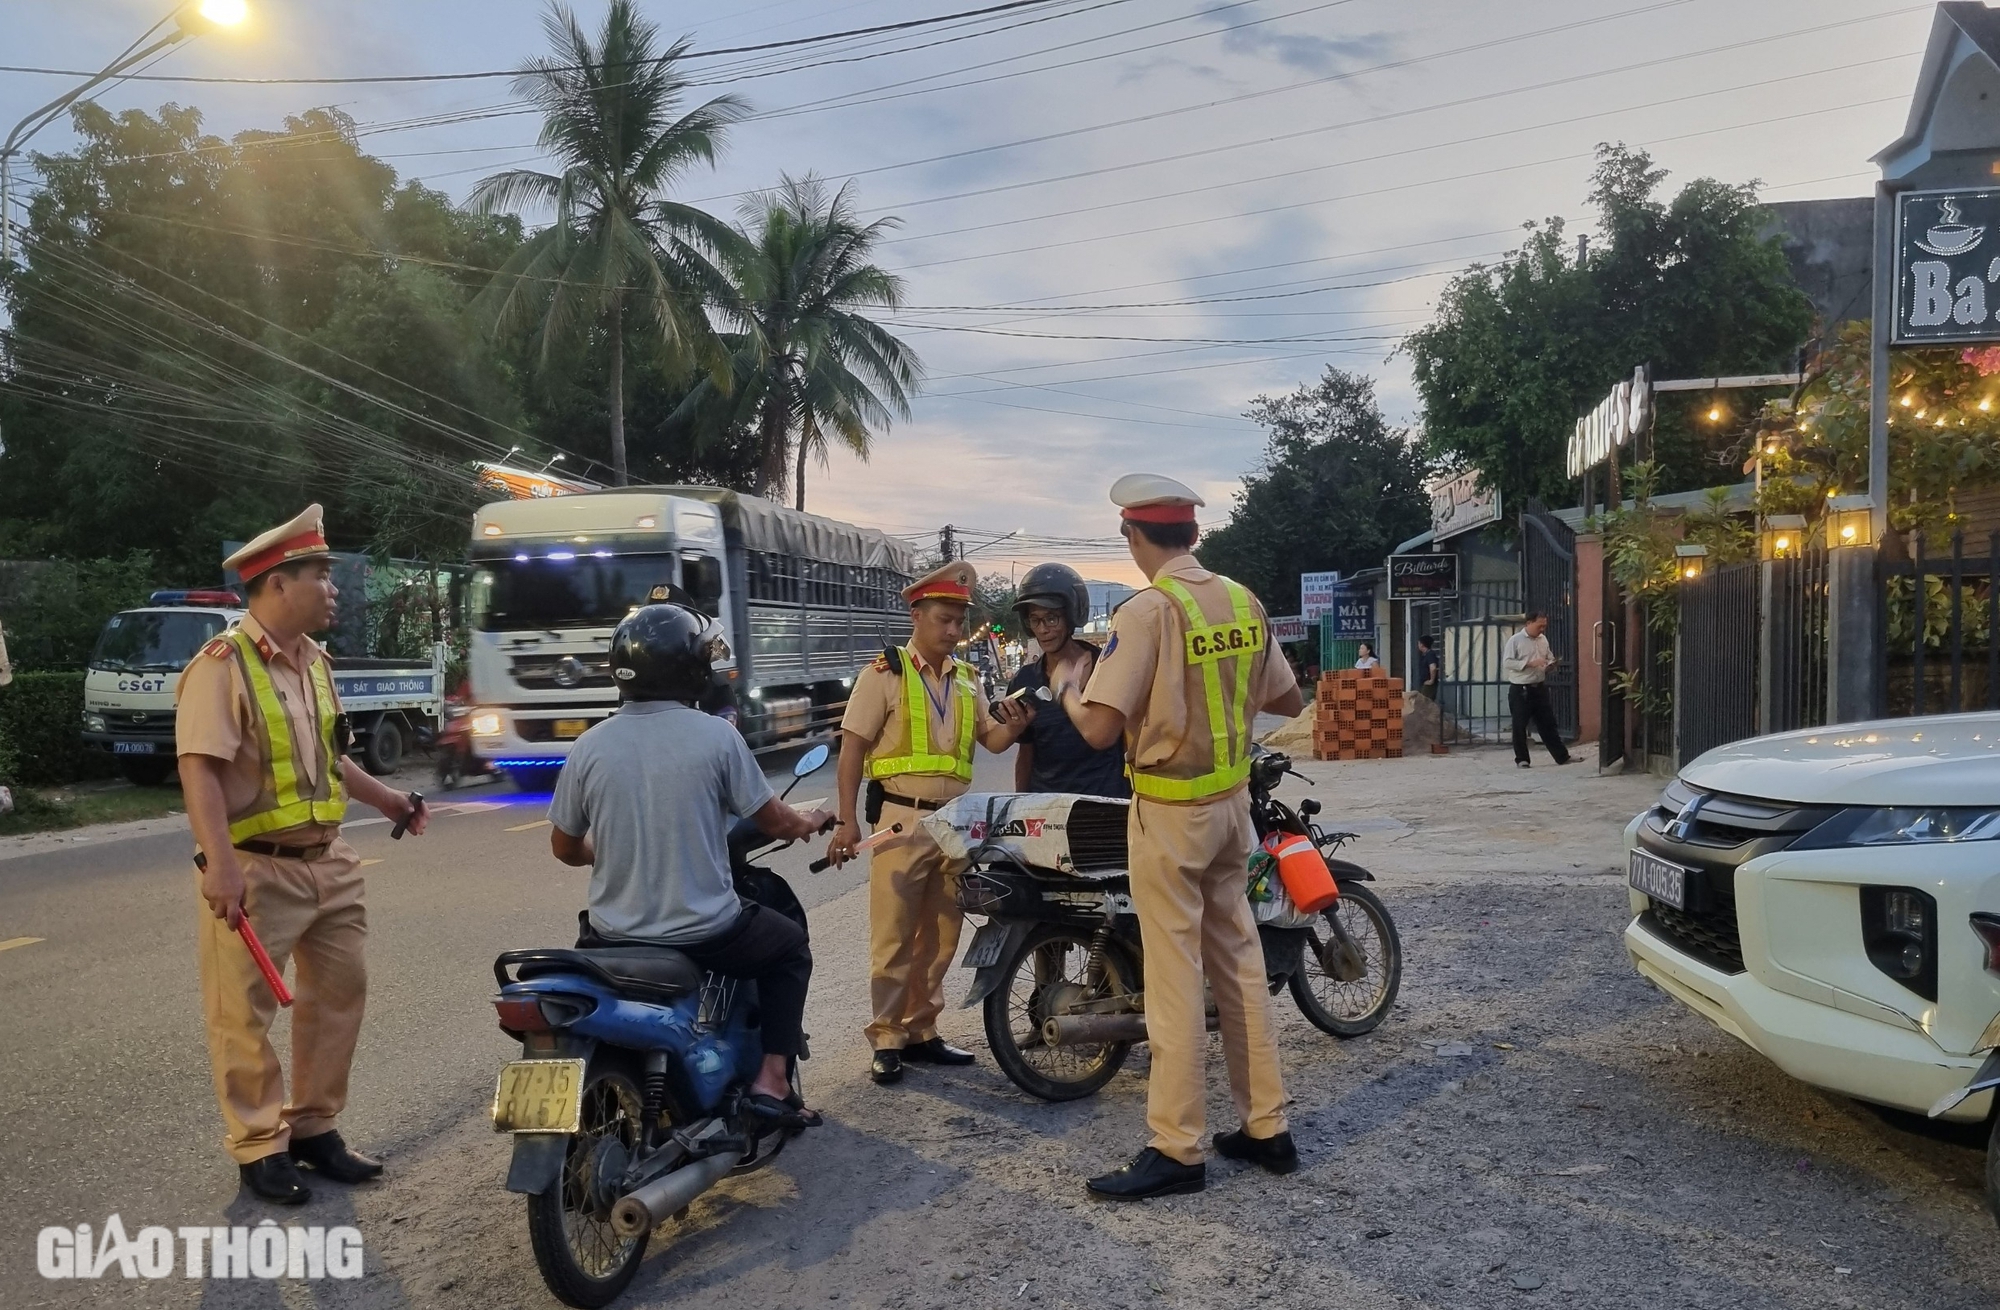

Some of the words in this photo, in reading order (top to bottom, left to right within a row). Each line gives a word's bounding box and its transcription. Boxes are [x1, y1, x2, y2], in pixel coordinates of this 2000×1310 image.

[1909, 257, 2000, 327] Ba
[1341, 619, 1366, 630] NAI
[1192, 626, 1257, 657] C.S.G.T
[118, 680, 165, 691] CSGT
[353, 680, 368, 693] SÁT
[376, 683, 396, 692] GIAO
[399, 679, 425, 691] THÔNG
